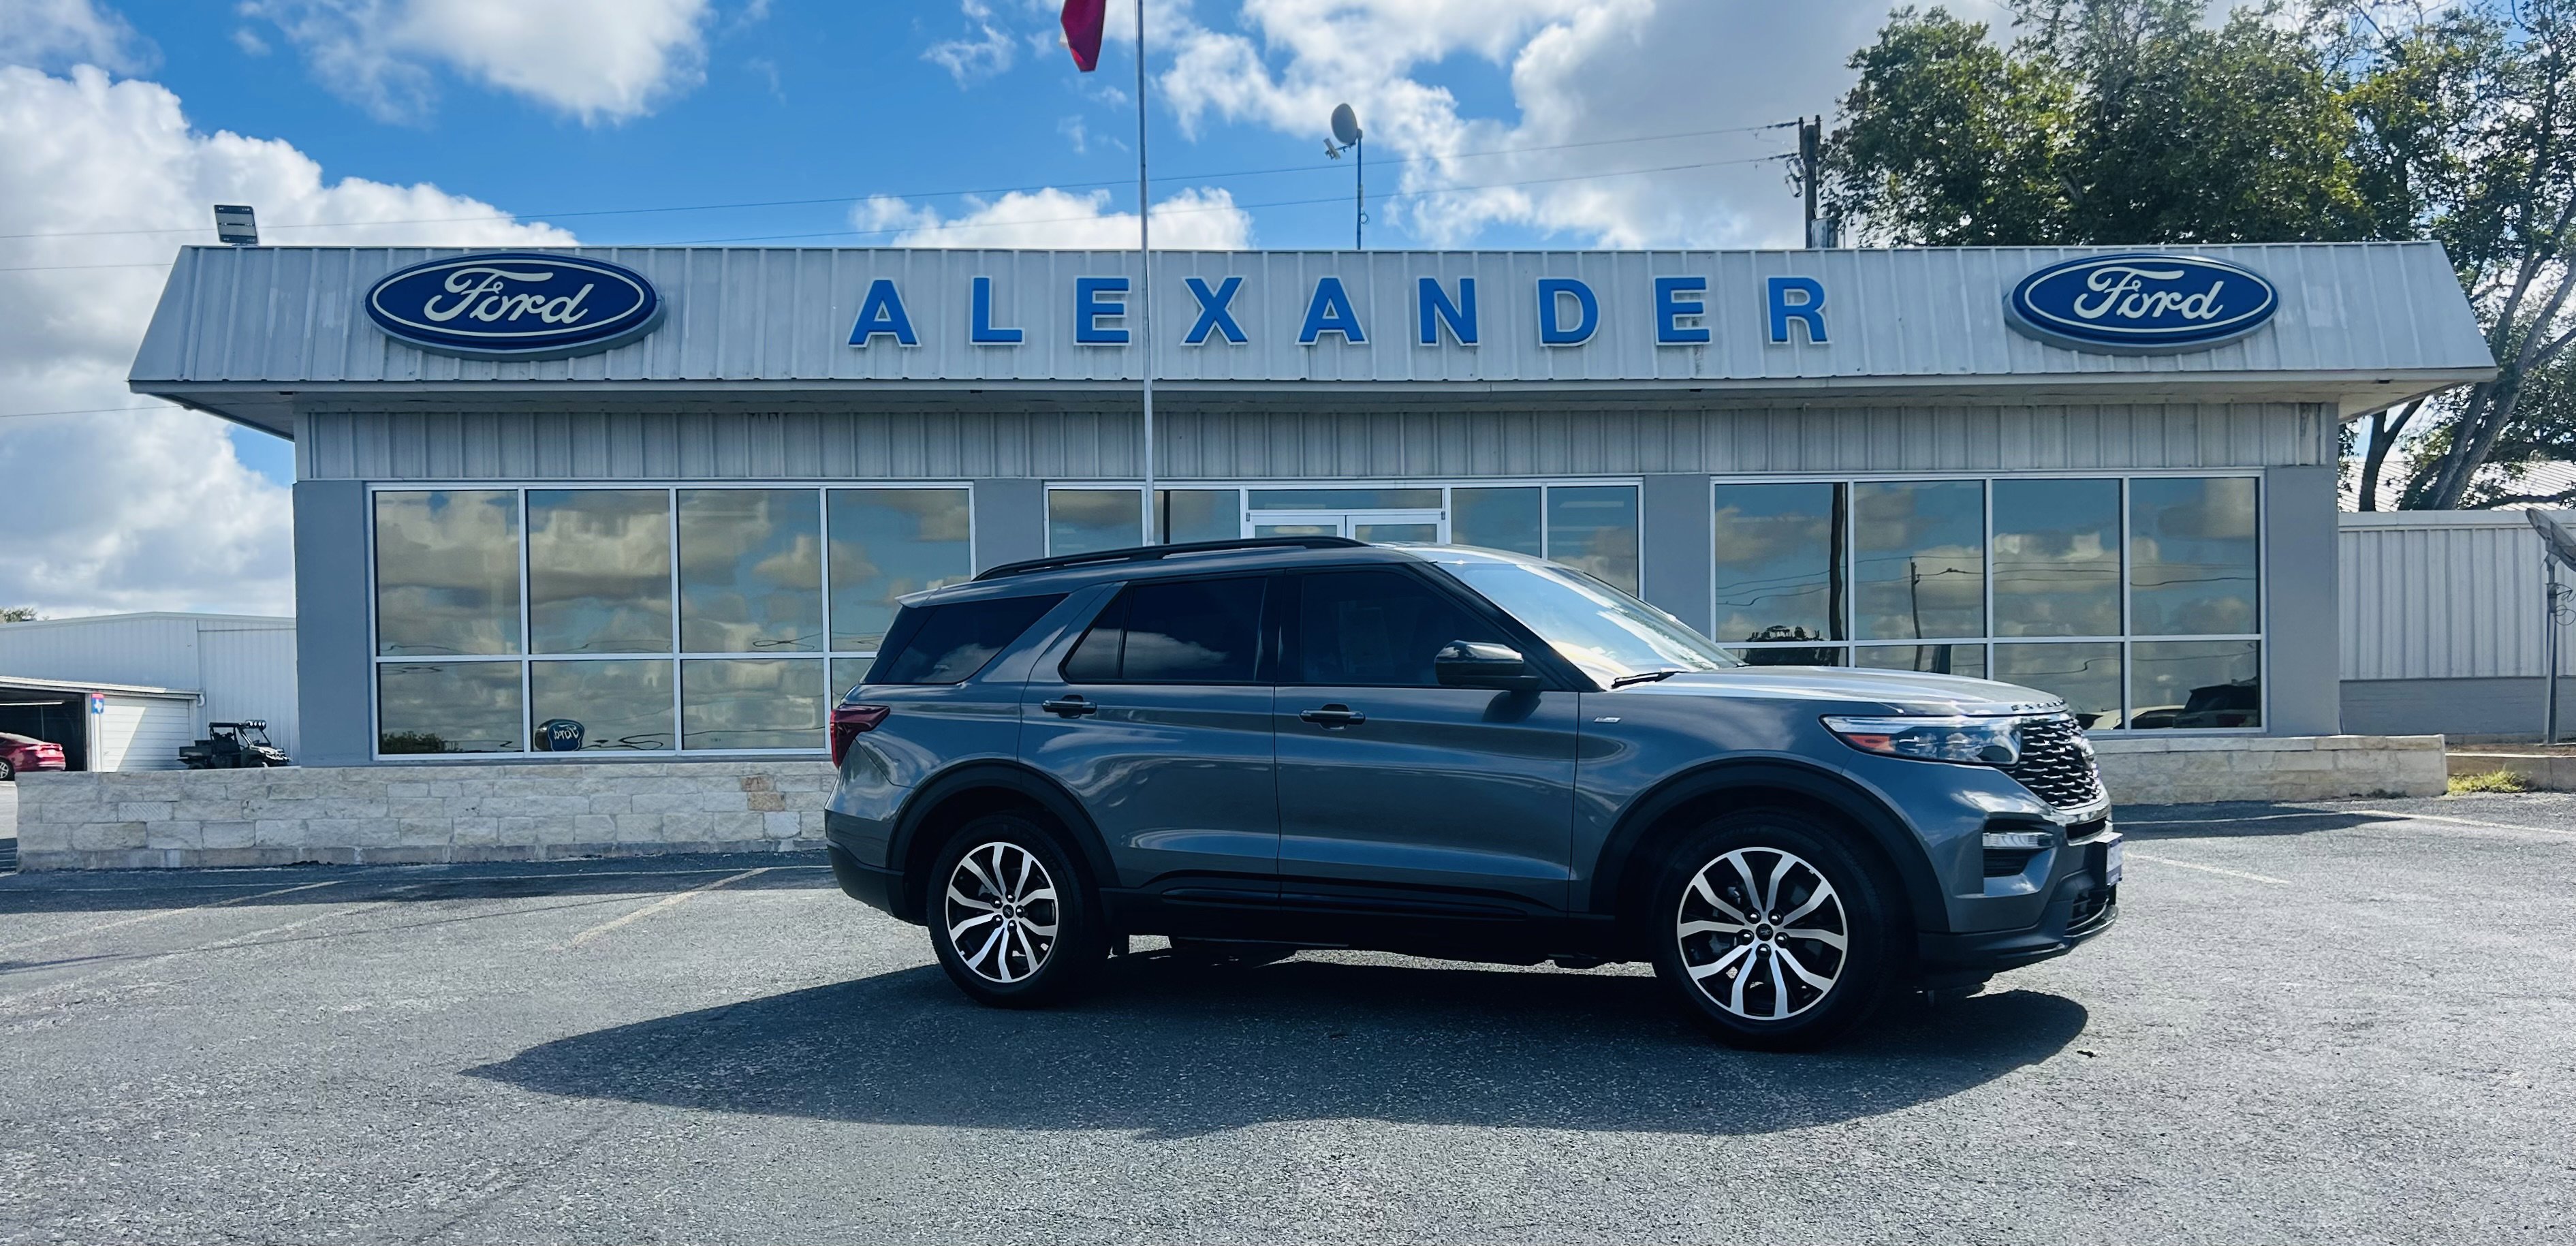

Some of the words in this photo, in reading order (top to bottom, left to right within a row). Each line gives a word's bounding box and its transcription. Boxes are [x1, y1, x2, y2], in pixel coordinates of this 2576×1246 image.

[424, 267, 595, 324] Ford
[848, 275, 1834, 347] ALEXANDER
[2073, 266, 2225, 320] Ford
